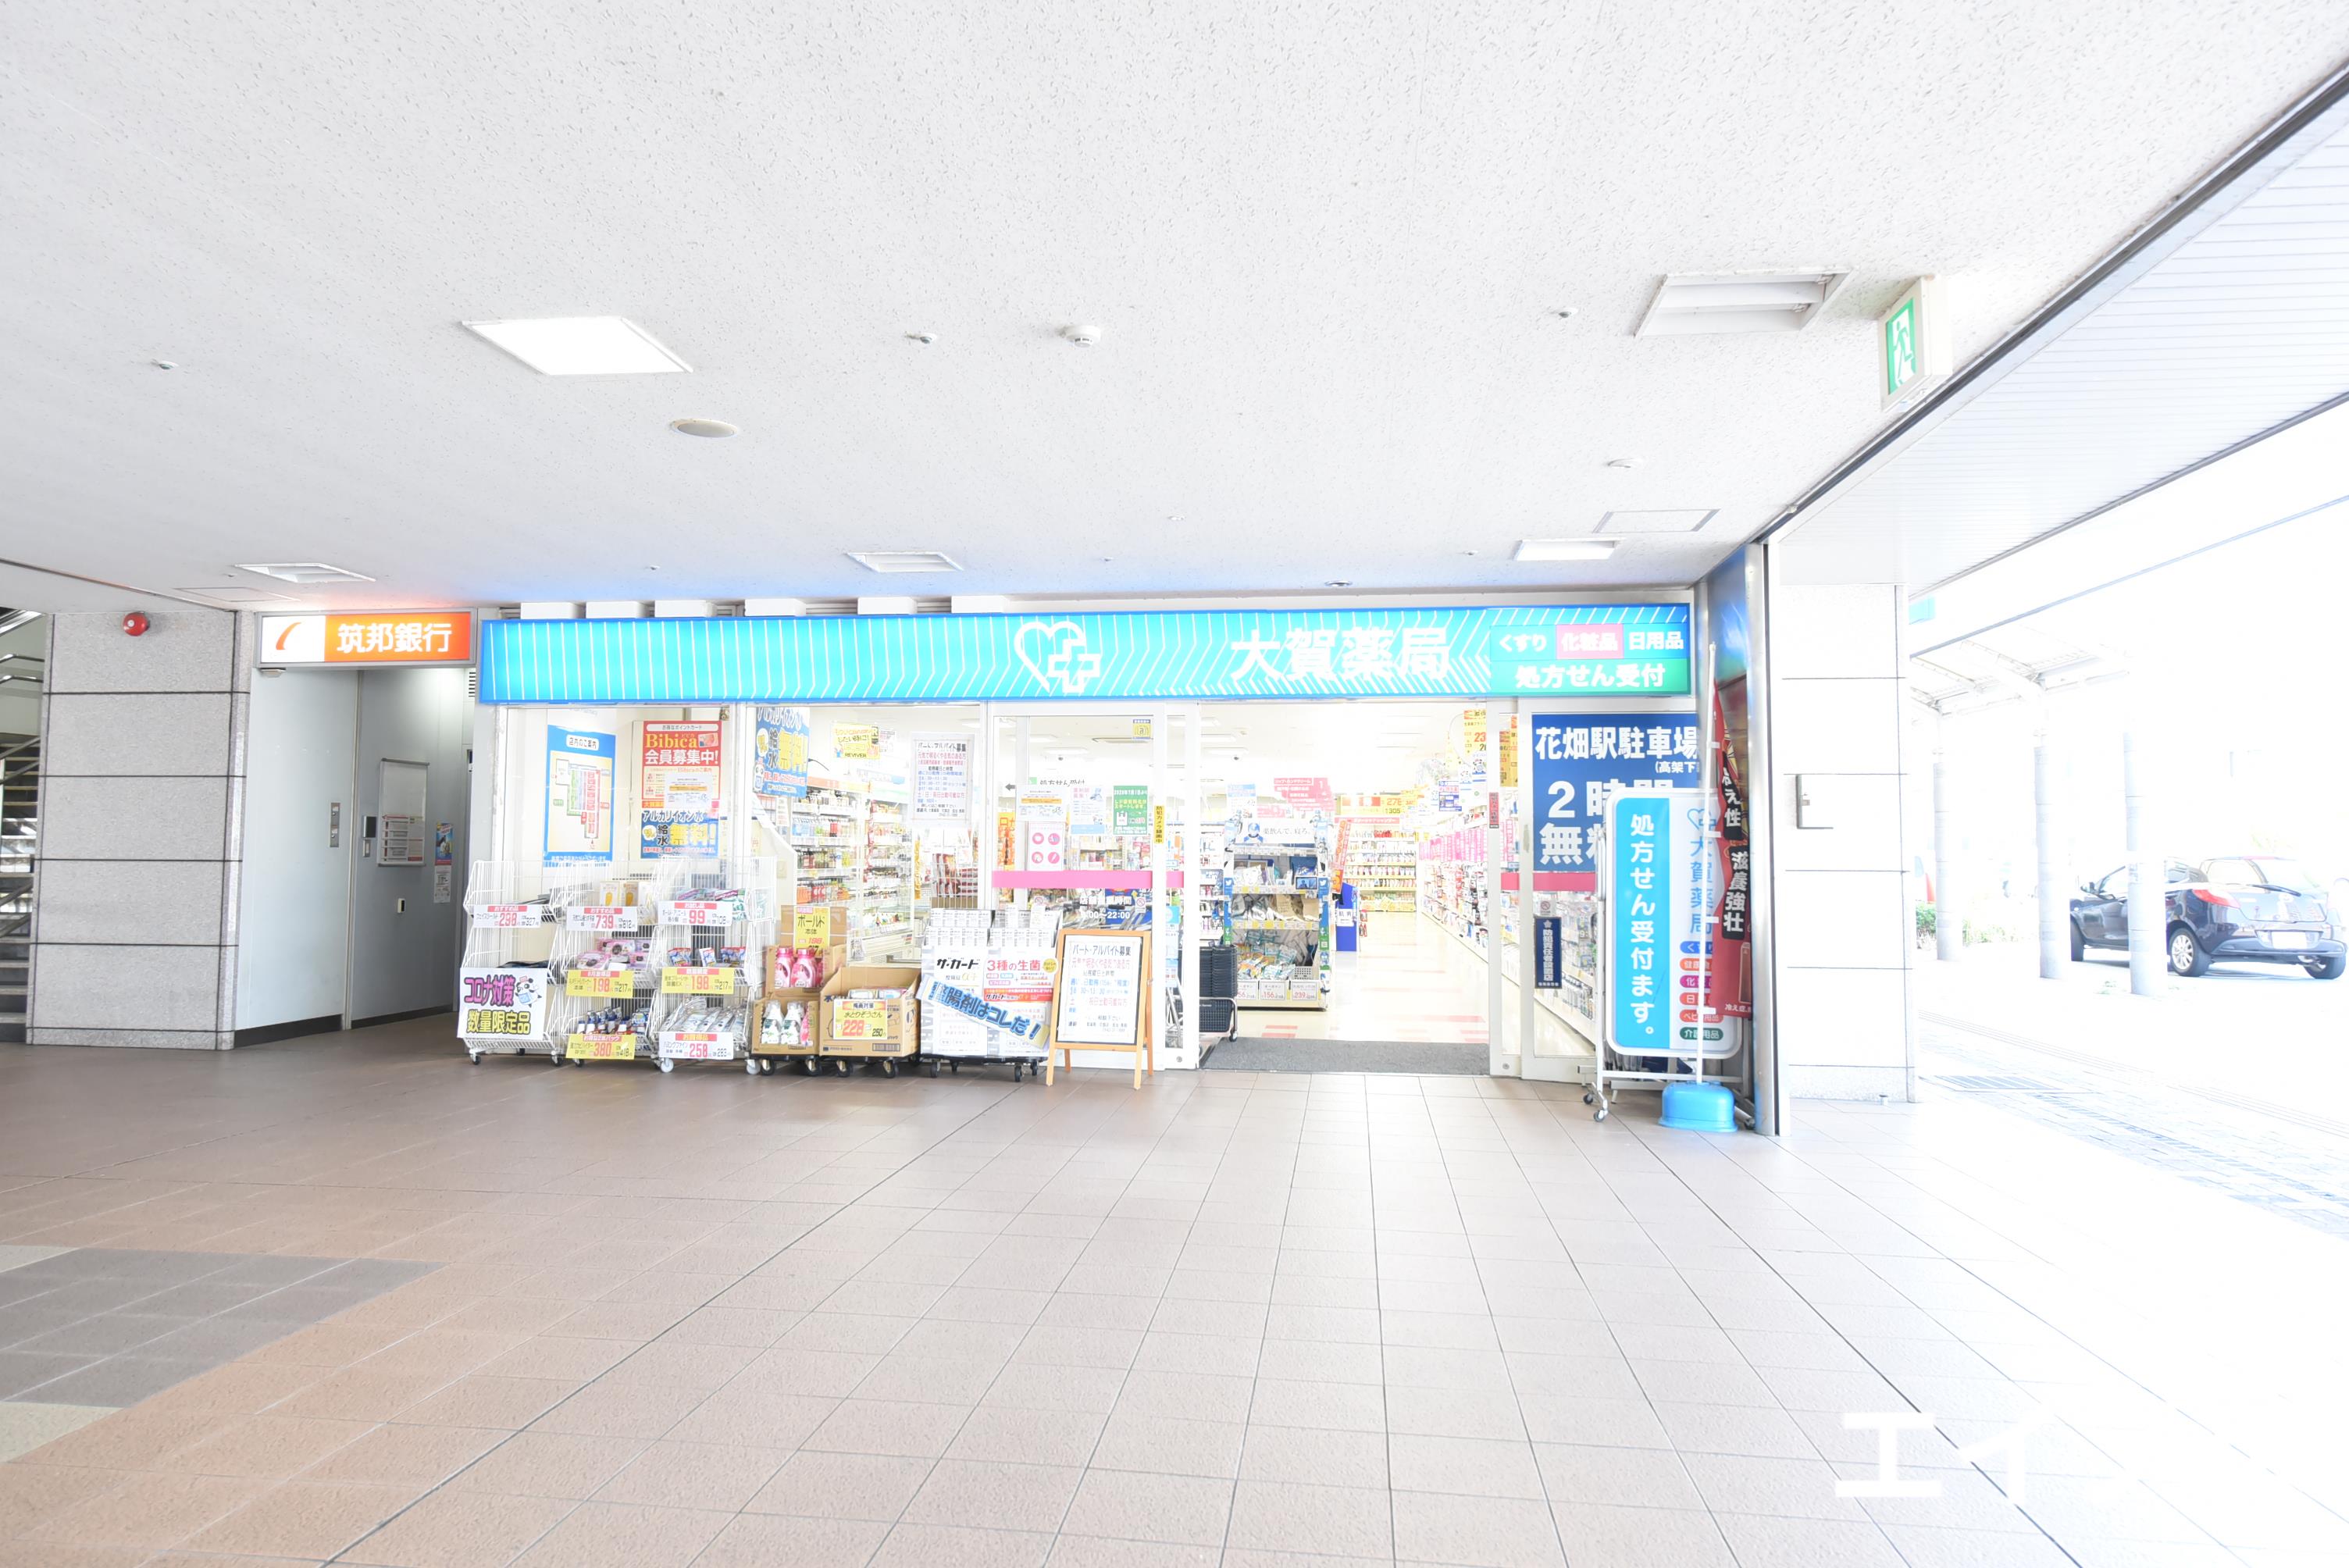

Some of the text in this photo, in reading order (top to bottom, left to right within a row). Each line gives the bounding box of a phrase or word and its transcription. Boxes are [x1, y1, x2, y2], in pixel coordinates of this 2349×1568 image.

[337, 622, 452, 654] 筑邦銀行
[1499, 633, 1547, 652] くすり
[1562, 633, 1618, 651] 化粧品
[1629, 631, 1684, 650] 日用品
[1231, 626, 1451, 682] 大賀薬局
[1516, 664, 1666, 688] 処方せん受付
[569, 737, 597, 750] 店内のご案内
[645, 733, 697, 749] Bibica
[1535, 726, 1698, 761] 花畑駅駐車場
[645, 750, 718, 765] 会員募集中!
[1548, 779, 1674, 818] 2時
[499, 913, 518, 927] 298
[595, 915, 614, 928] 739
[689, 910, 706, 925] 99
[797, 914, 825, 928] ボールド
[1631, 814, 1656, 1035] 処方せん受付ます。
[1072, 944, 1132, 957] パート・アルバイト募集
[937, 957, 981, 970] ザ・ガード
[987, 960, 1041, 971] 3種の生菌
[593, 978, 611, 992] 198
[692, 976, 709, 990] 198
[464, 975, 516, 1007] コロナ対策
[466, 1009, 532, 1035] 数量限定品
[842, 1019, 865, 1037] 228
[872, 1028, 883, 1037] 250
[593, 1042, 612, 1057] 380
[690, 1043, 708, 1058] 258
